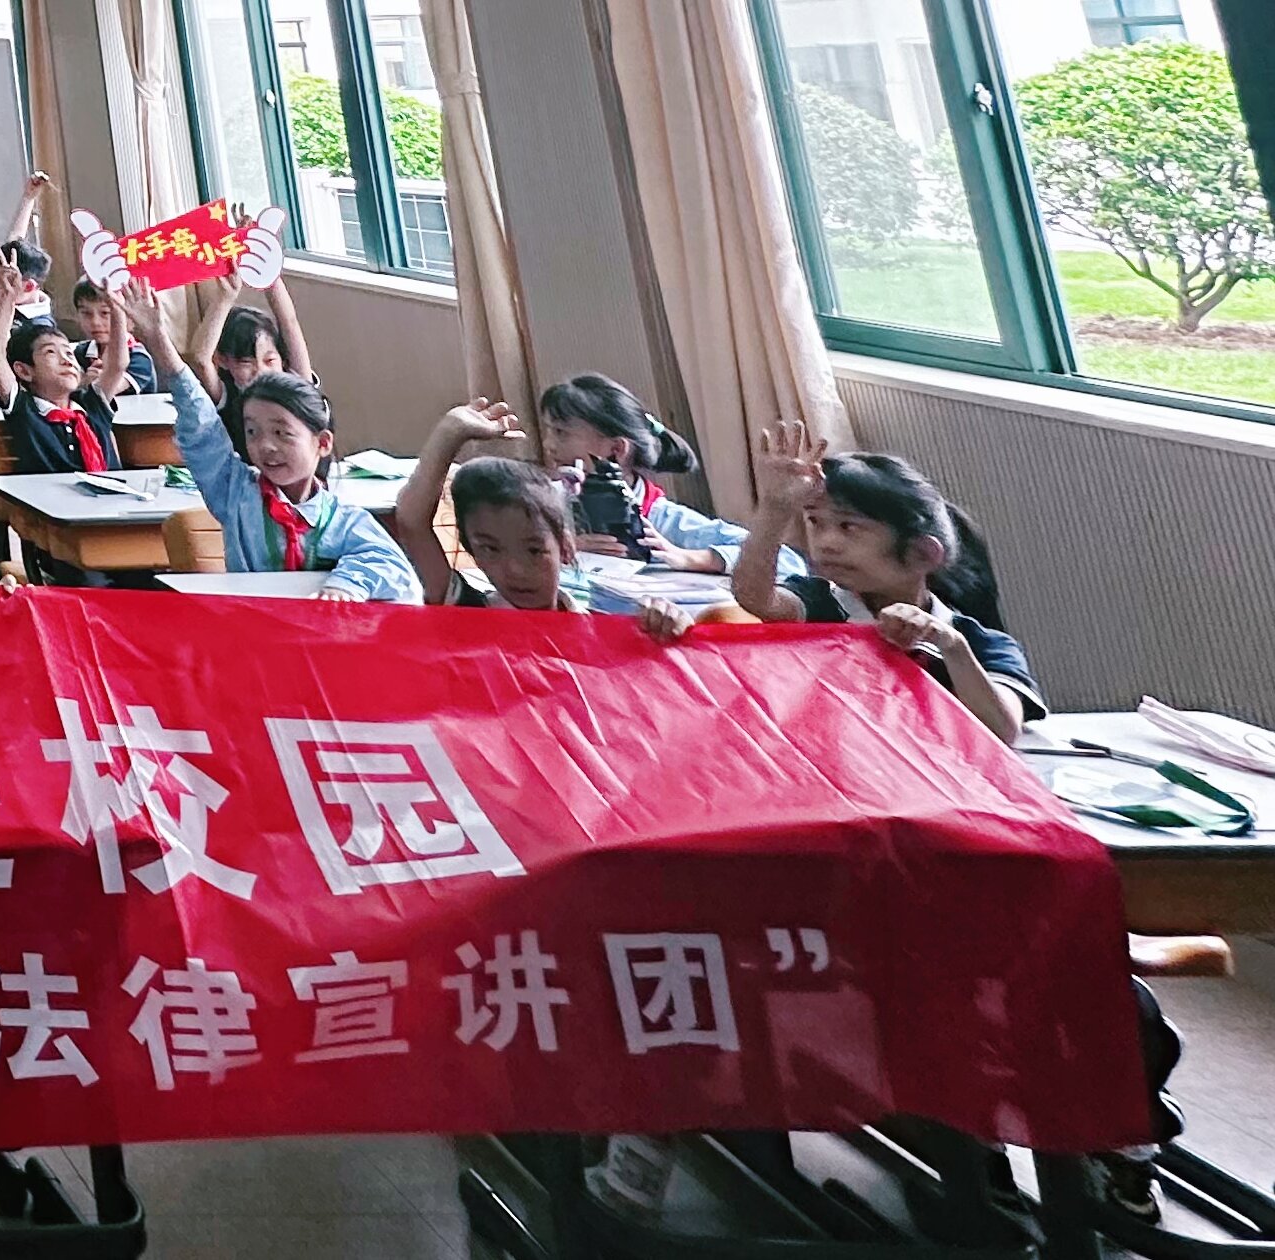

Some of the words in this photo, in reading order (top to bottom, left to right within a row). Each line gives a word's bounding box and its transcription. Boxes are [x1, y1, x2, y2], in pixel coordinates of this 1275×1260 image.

[120, 227, 247, 265] 大手牵小手
